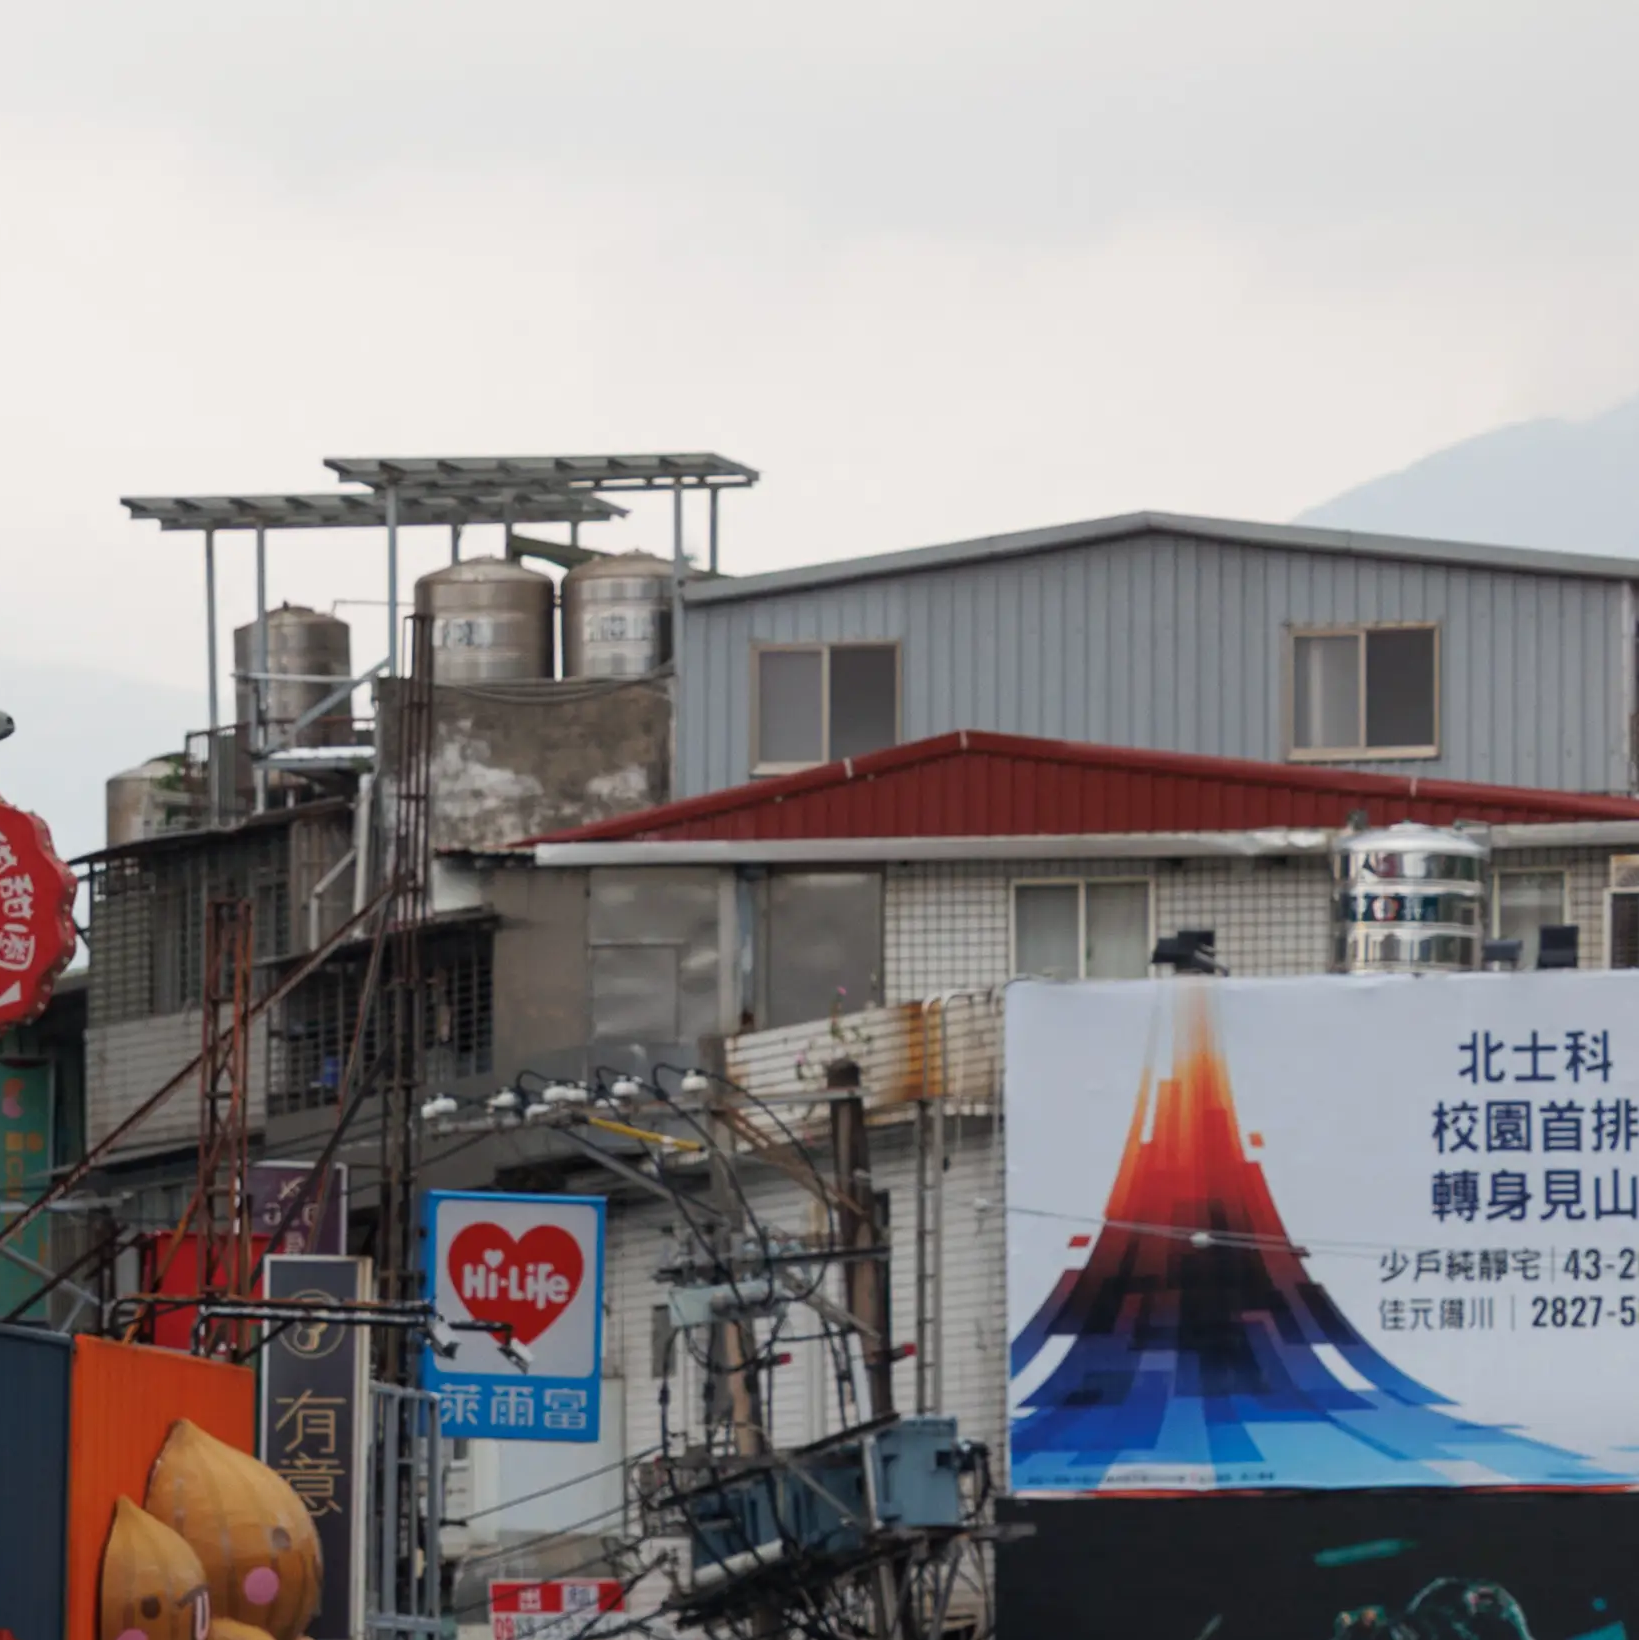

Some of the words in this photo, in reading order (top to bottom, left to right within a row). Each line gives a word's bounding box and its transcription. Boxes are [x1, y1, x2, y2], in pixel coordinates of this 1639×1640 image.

[1458, 1030, 1613, 1085] 北士科
[1432, 1099, 1639, 1154] 校園首排
[1432, 1169, 1639, 1222] 轉身見山
[462, 1250, 570, 1310] Hi-Life
[1379, 1249, 1541, 1283] 少戶純靜宅
[438, 1383, 587, 1430] 萊爾富
